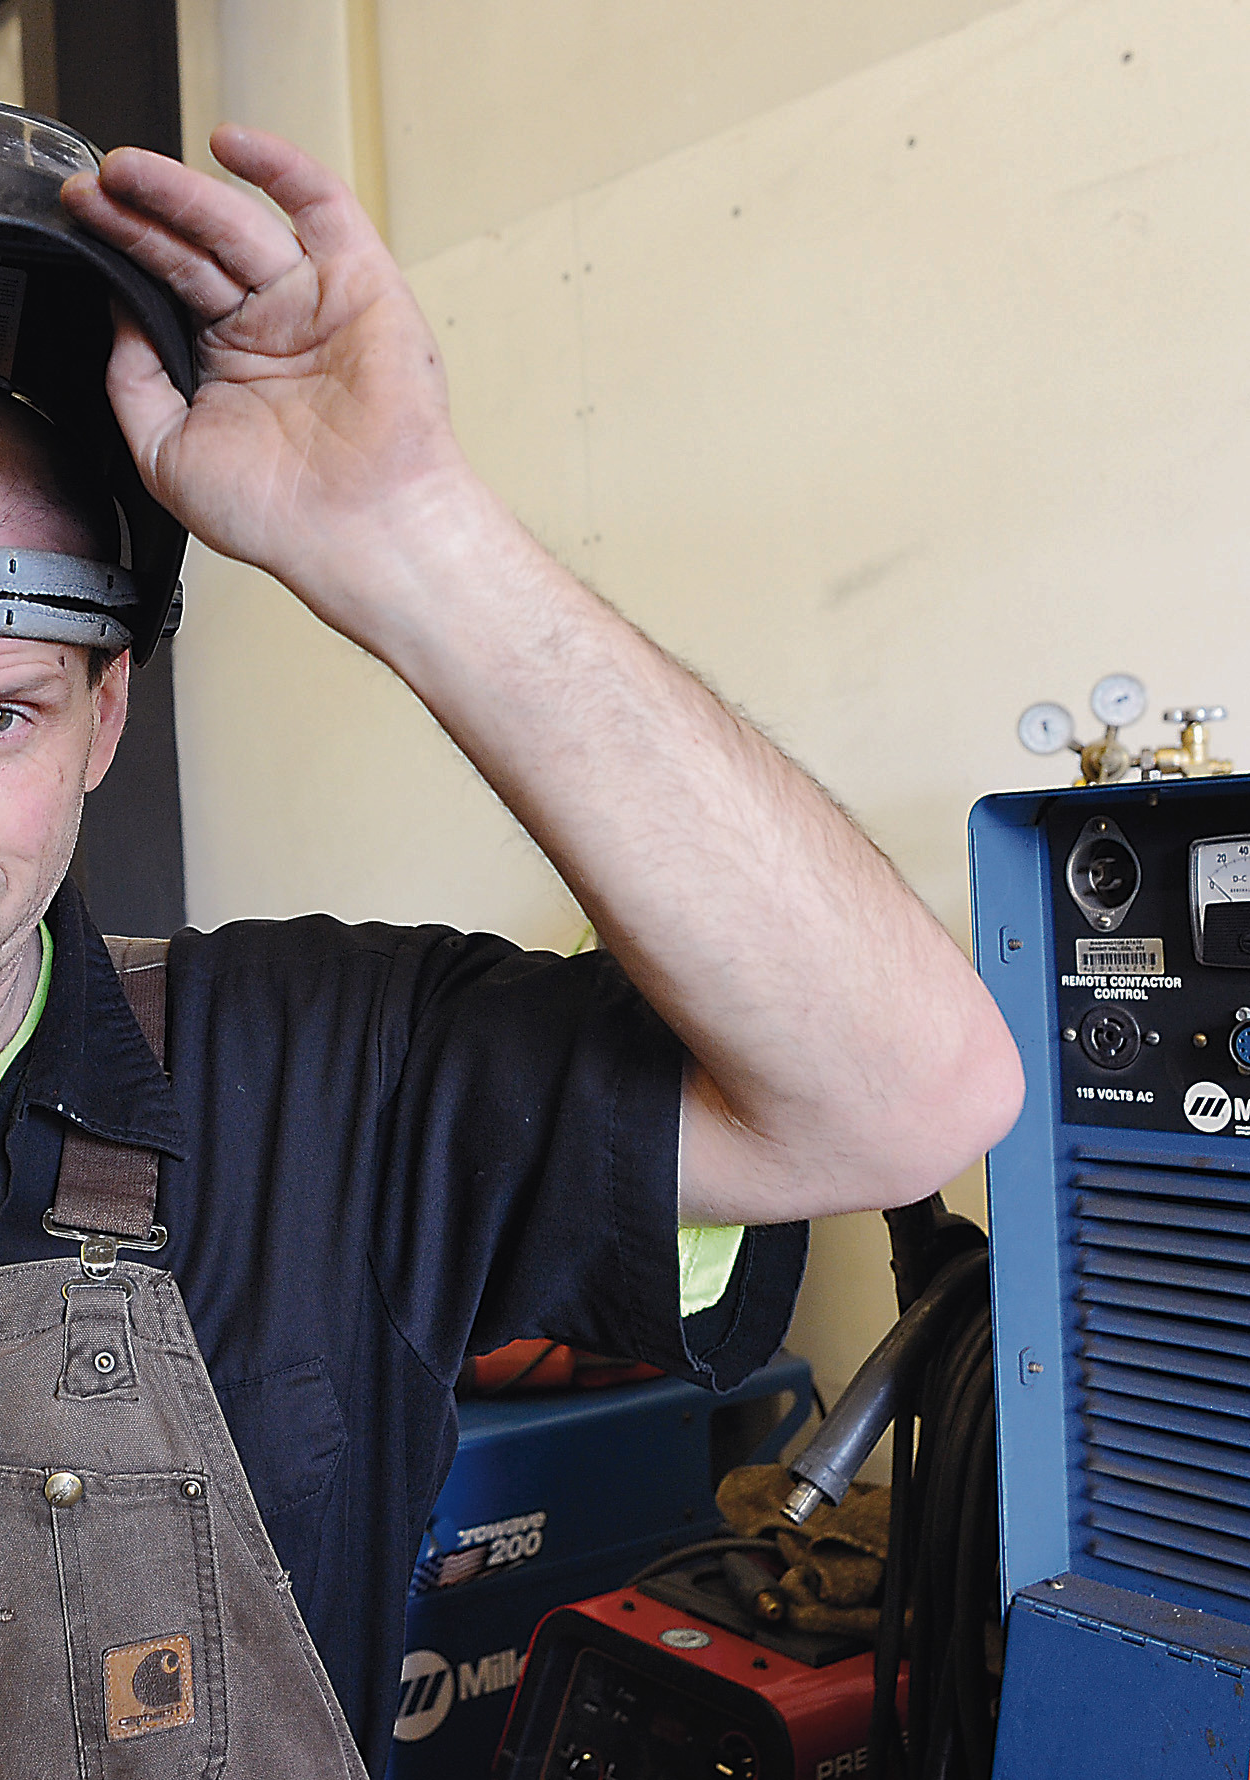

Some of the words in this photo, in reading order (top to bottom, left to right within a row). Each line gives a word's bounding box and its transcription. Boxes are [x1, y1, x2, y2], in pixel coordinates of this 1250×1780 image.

[1239, 846, 1249, 855] 40
[1217, 853, 1226, 863] 20
[1209, 880, 1215, 889] 0
[1061, 975, 1107, 987] REMOTE
[1110, 976, 1182, 988] CONTACTOR
[1094, 988, 1149, 1000] CONTROL
[1076, 1087, 1095, 1099] 115
[1096, 1088, 1134, 1102] VOLTS
[1136, 1091, 1154, 1103] AC
[486, 1529, 543, 1566] 200
[816, 1746, 869, 1780] PRE
